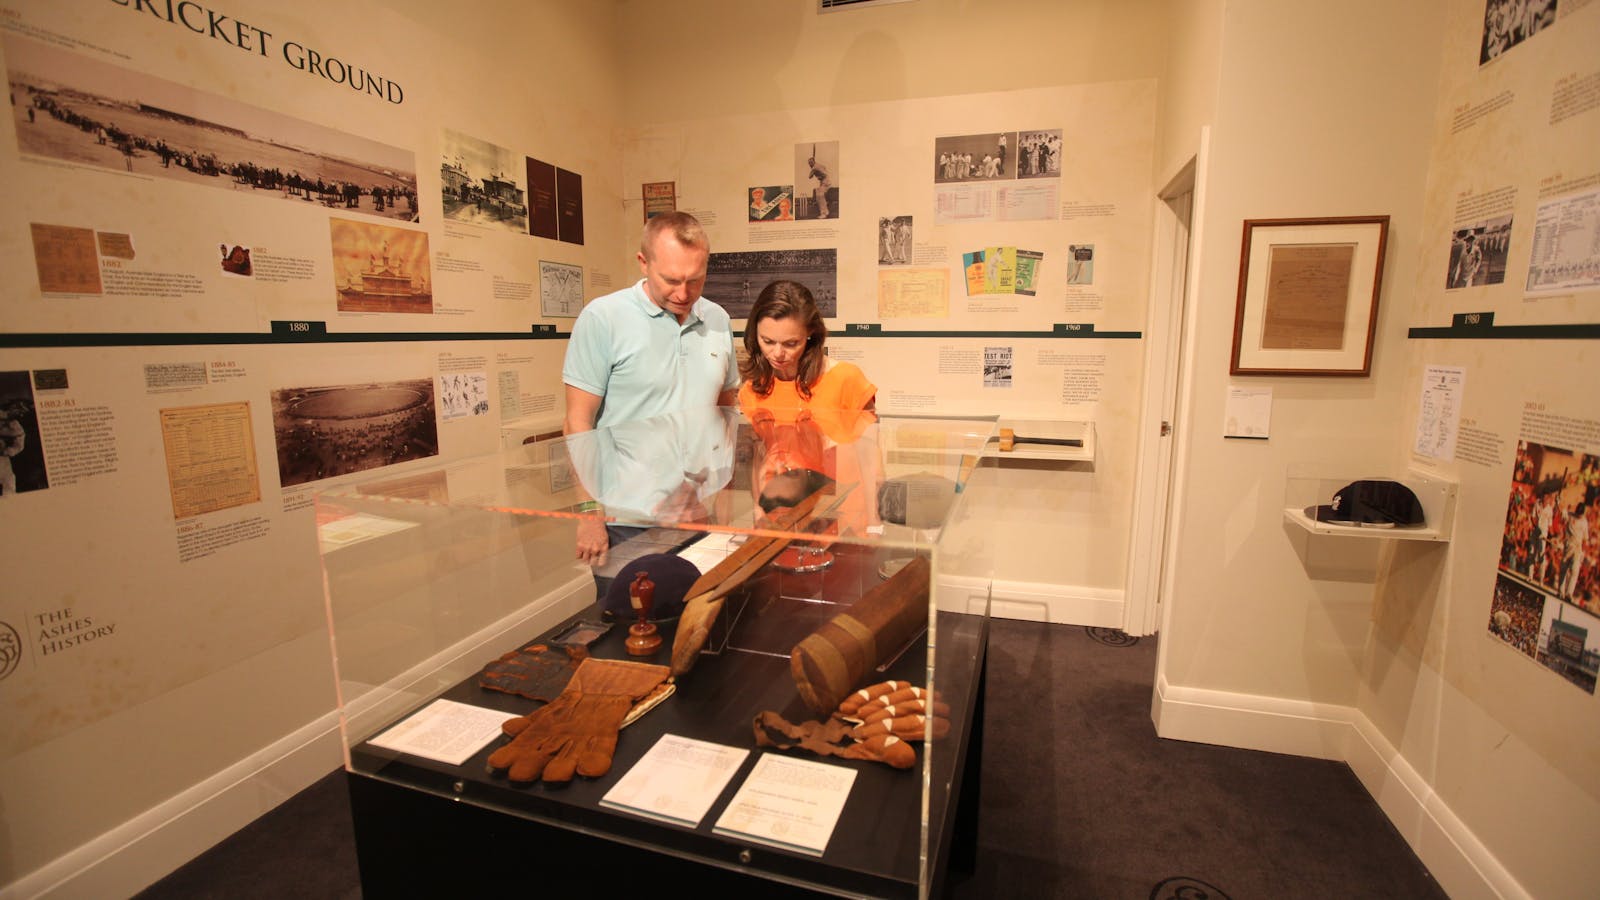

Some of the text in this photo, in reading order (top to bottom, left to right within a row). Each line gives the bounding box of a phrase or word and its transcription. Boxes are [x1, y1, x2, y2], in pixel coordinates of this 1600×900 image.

[110, 0, 273, 57] ICKET
[282, 41, 404, 105] GROUND
[289, 322, 310, 332] 1880
[1464, 313, 1480, 325] 1980
[34, 607, 73, 626] THE
[39, 616, 92, 642] ASHES
[42, 624, 115, 656] HISTORY
